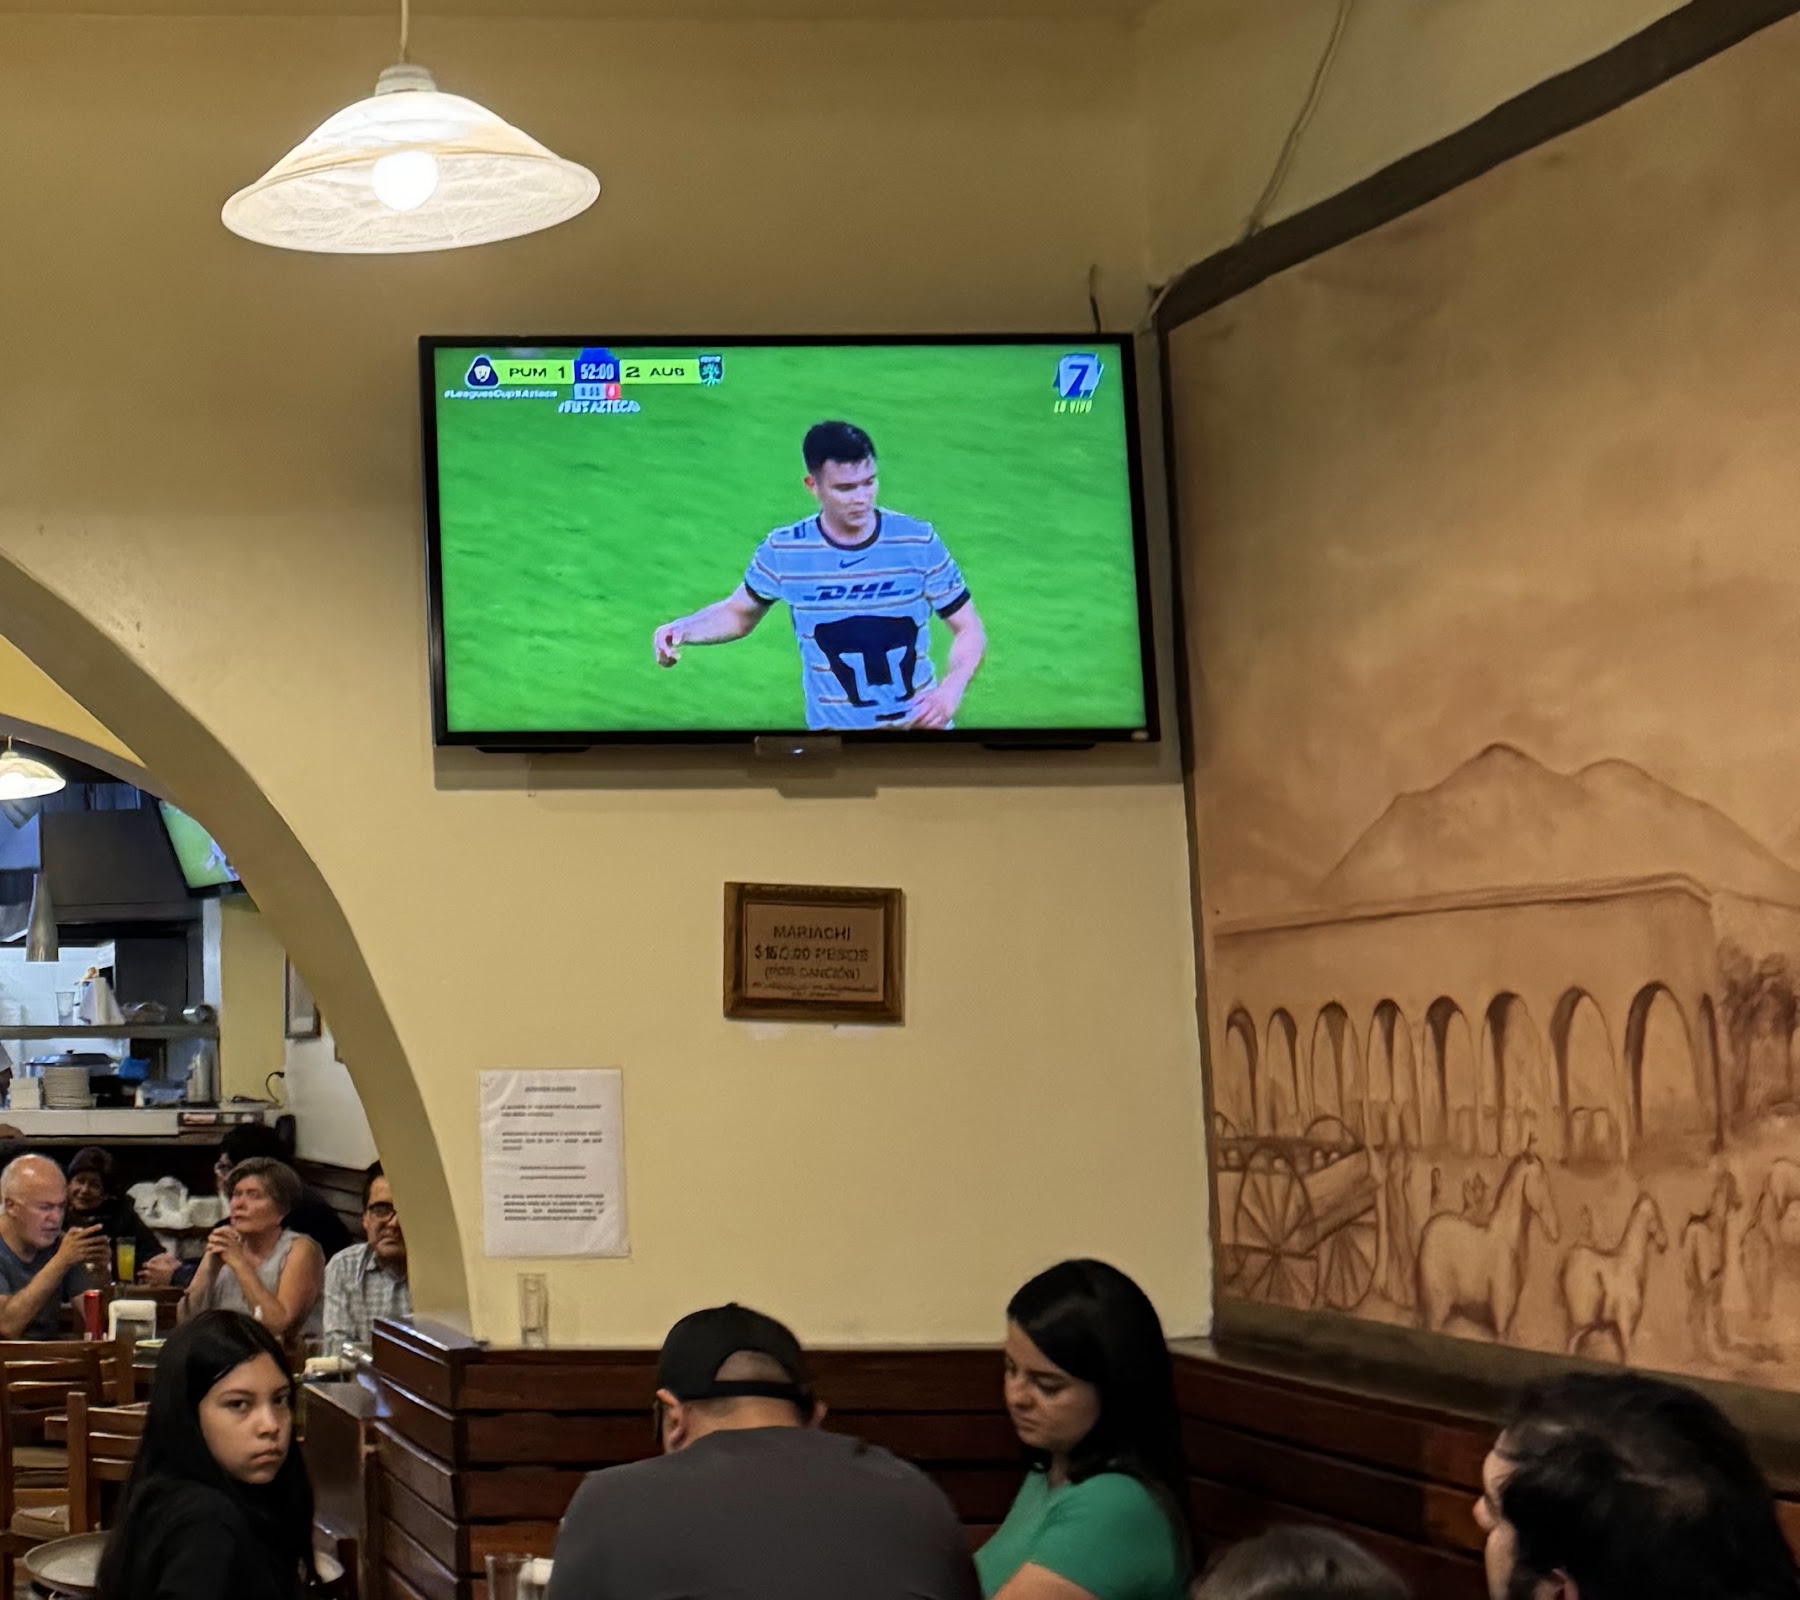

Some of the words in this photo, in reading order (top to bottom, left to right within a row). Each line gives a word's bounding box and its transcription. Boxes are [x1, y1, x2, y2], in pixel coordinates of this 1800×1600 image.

[509, 367, 547, 378] PUM
[558, 366, 565, 379] 1
[580, 362, 615, 380] 52:00
[625, 366, 641, 378] 2
[812, 580, 902, 601] DHL
[773, 925, 851, 941] MARIACHI
